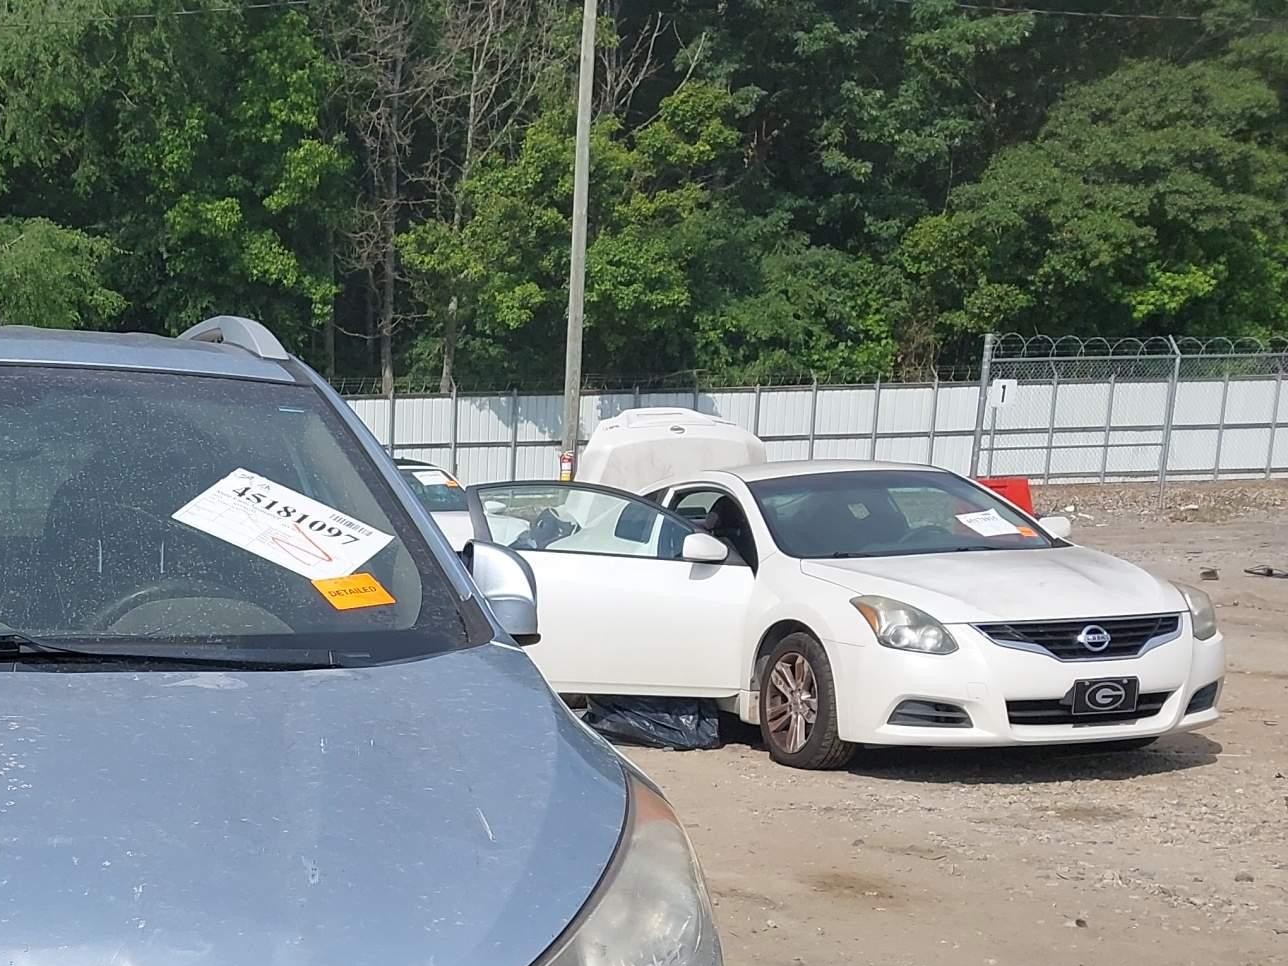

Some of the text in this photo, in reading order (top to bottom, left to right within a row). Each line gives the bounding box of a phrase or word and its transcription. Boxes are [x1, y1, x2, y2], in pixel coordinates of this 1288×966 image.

[1000, 384, 1007, 403] 1
[232, 486, 361, 546] 45181097
[327, 585, 377, 598] DETAILED
